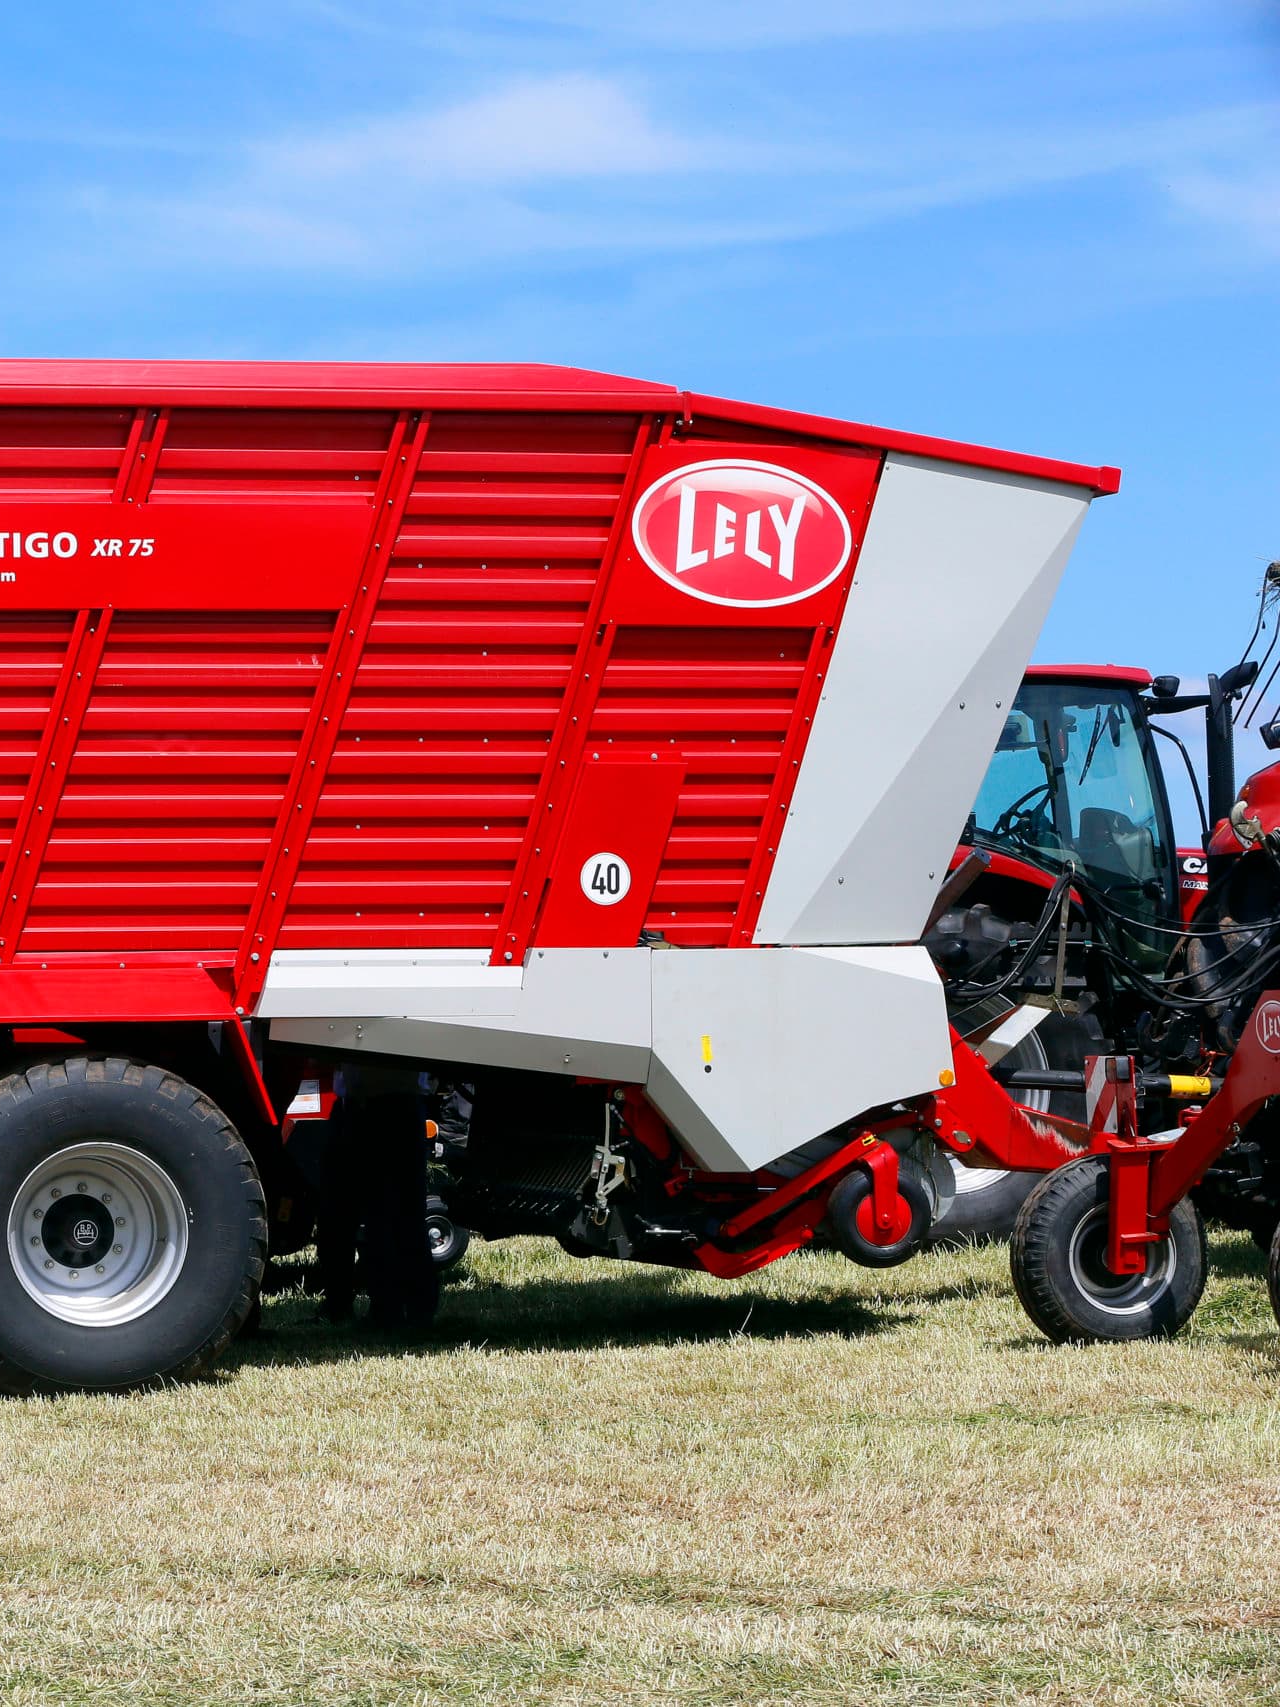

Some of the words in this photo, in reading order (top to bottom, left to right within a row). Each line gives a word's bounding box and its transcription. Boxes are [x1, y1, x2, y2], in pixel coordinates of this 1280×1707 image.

[90, 539, 123, 557] XR
[128, 539, 155, 557] 75
[676, 484, 807, 581] LELY
[591, 863, 620, 895] 40
